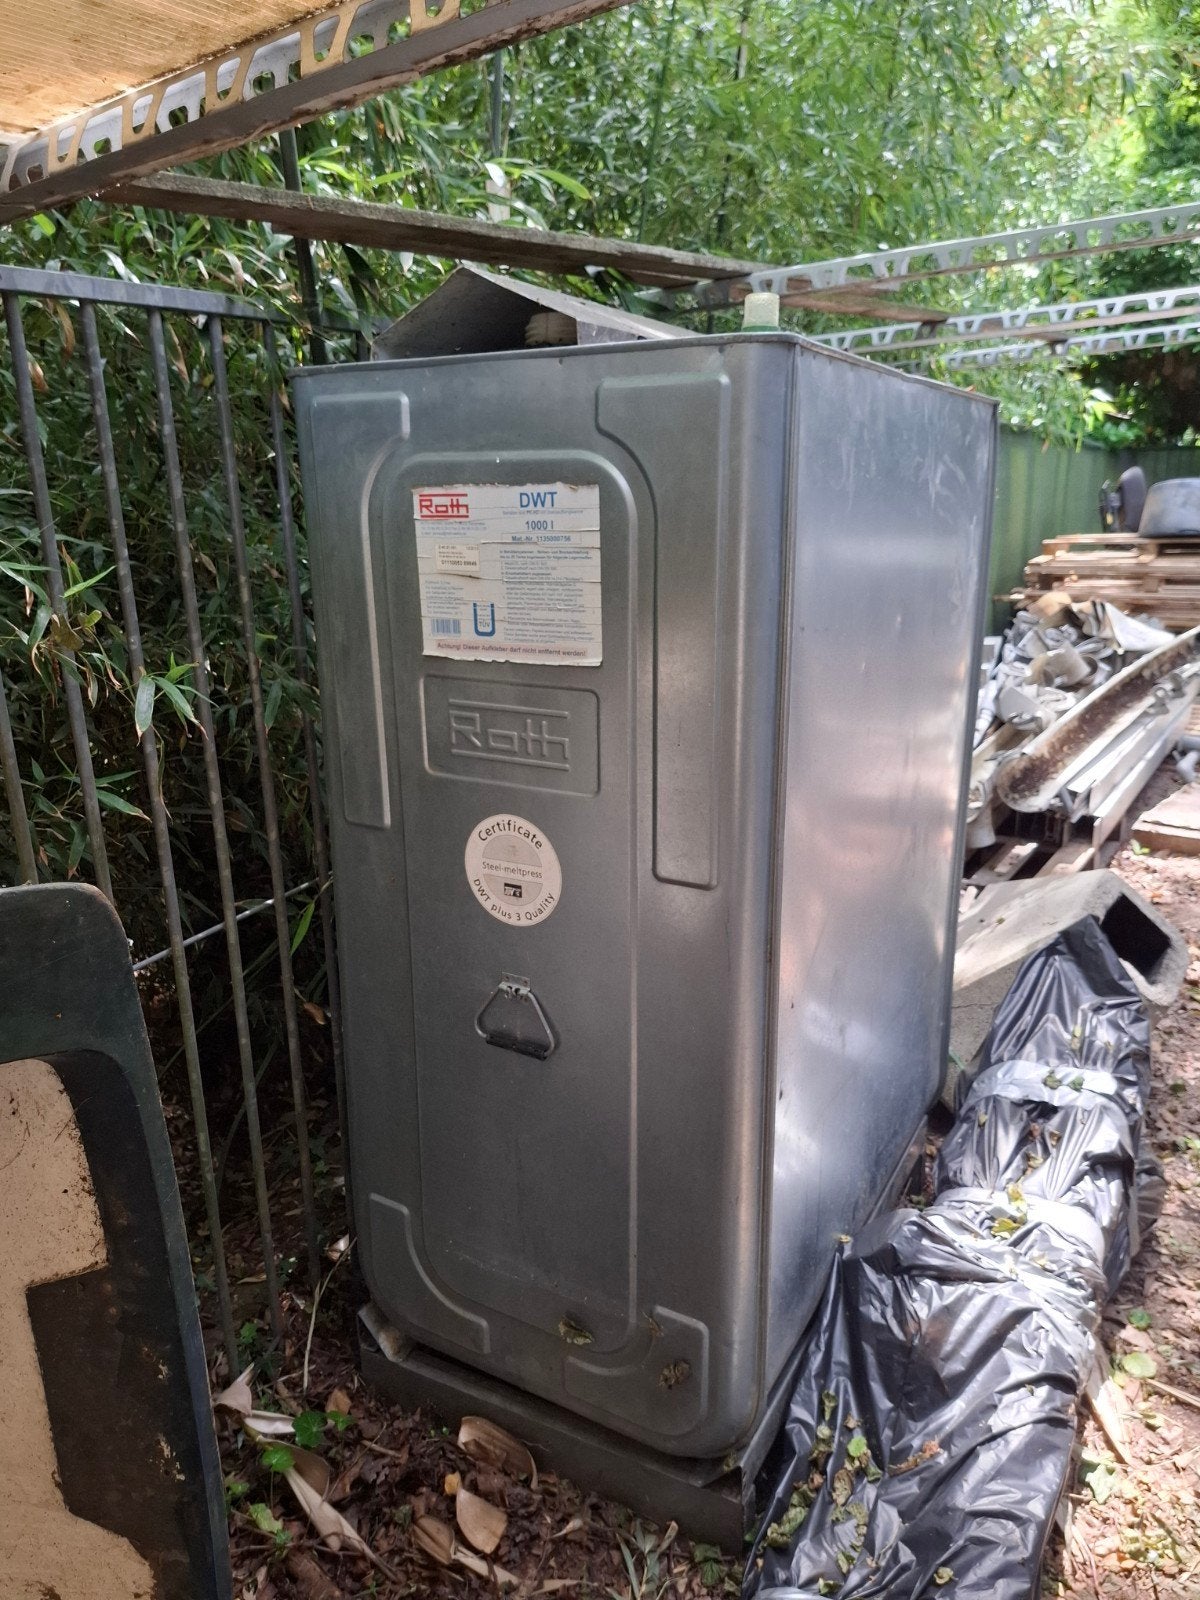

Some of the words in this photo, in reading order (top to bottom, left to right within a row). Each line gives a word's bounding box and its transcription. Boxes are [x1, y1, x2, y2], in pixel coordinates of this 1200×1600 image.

[419, 498, 469, 514] Roth
[519, 491, 557, 508] DWT
[525, 520, 548, 531] 1000
[449, 709, 570, 760] Roth
[478, 819, 543, 850] Certificate
[482, 861, 543, 879] Steel-meltpress
[473, 878, 491, 902] DWT
[490, 903, 512, 920] plus
[516, 912, 521, 921] 3
[524, 892, 556, 921] Quality
